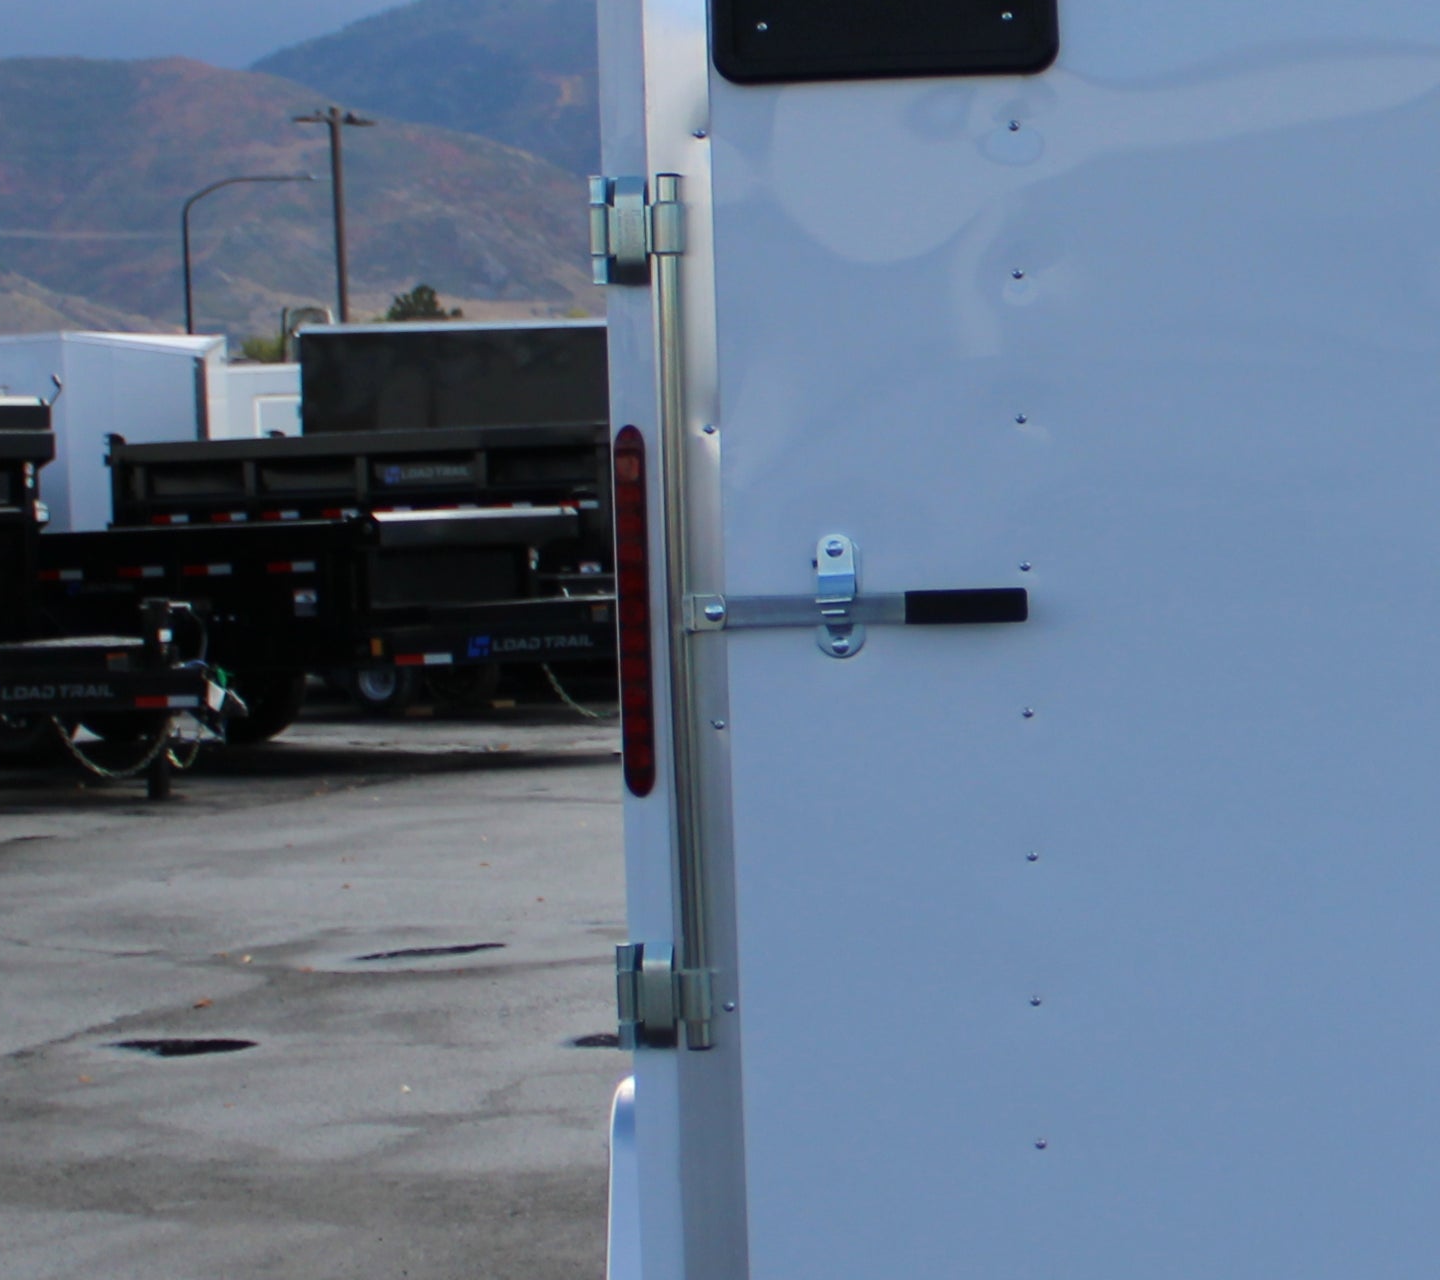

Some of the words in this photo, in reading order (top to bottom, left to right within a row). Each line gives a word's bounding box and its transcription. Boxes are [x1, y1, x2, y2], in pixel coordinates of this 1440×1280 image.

[492, 637, 540, 653] LOAD
[544, 633, 594, 649] TRAIL
[1, 685, 55, 700] LOAD
[59, 683, 115, 699] TRAIL
